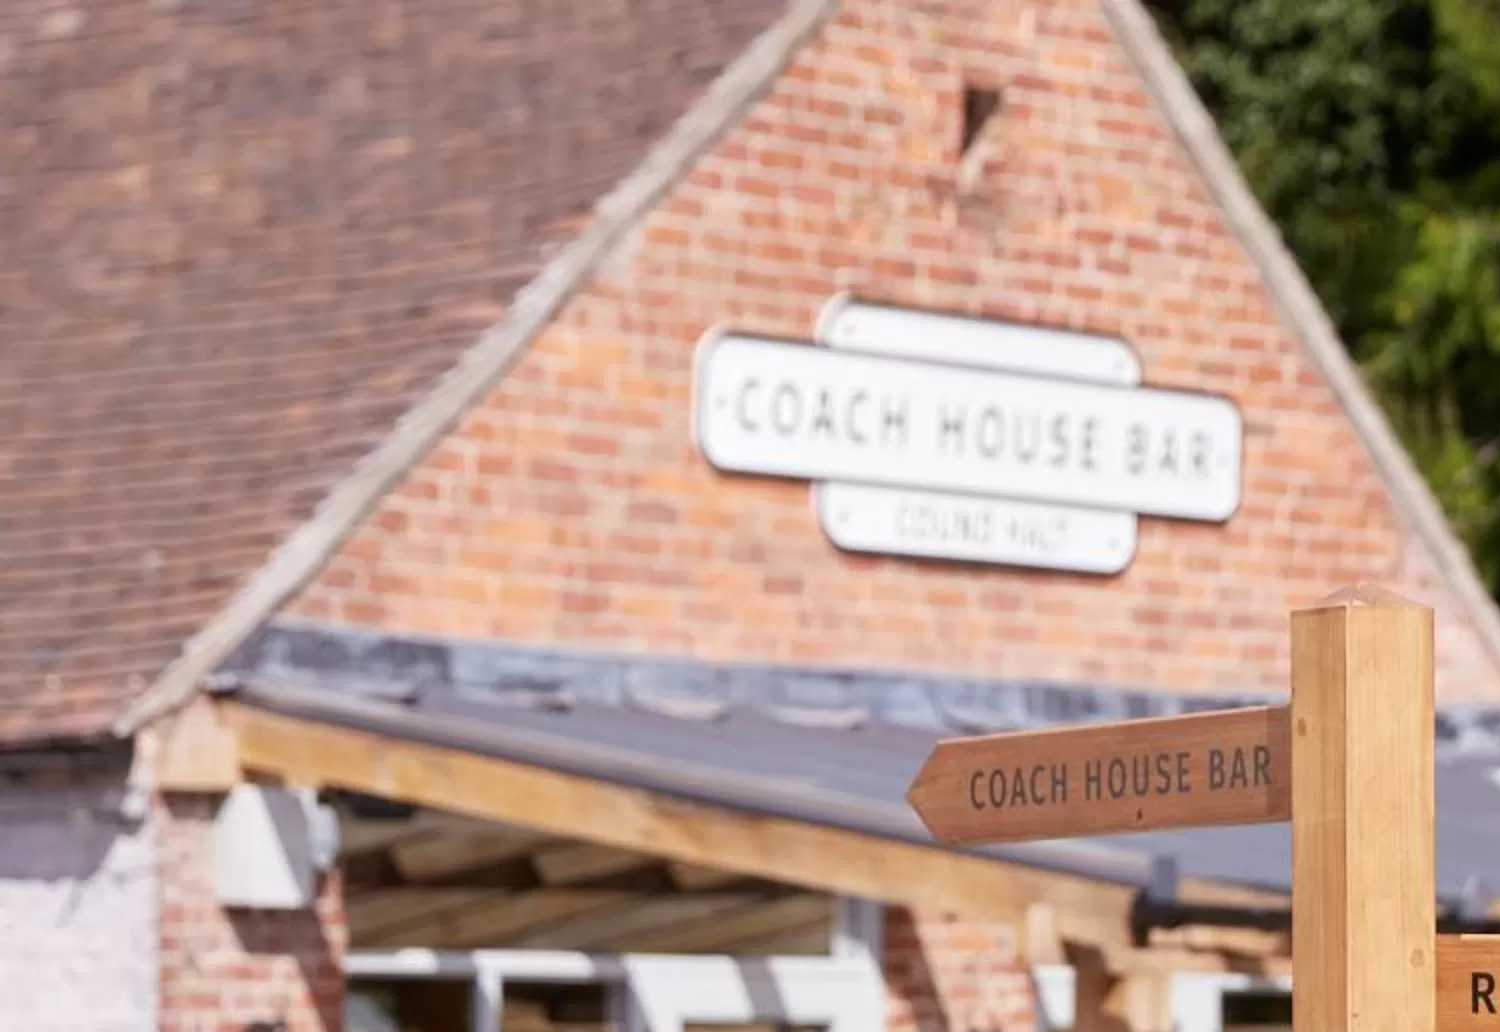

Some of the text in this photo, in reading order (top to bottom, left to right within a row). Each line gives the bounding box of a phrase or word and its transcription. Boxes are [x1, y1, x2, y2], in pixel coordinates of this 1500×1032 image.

[732, 374, 1215, 480] COACH HOUSE BAR
[969, 744, 1273, 811] COACH HOUSE BAR
